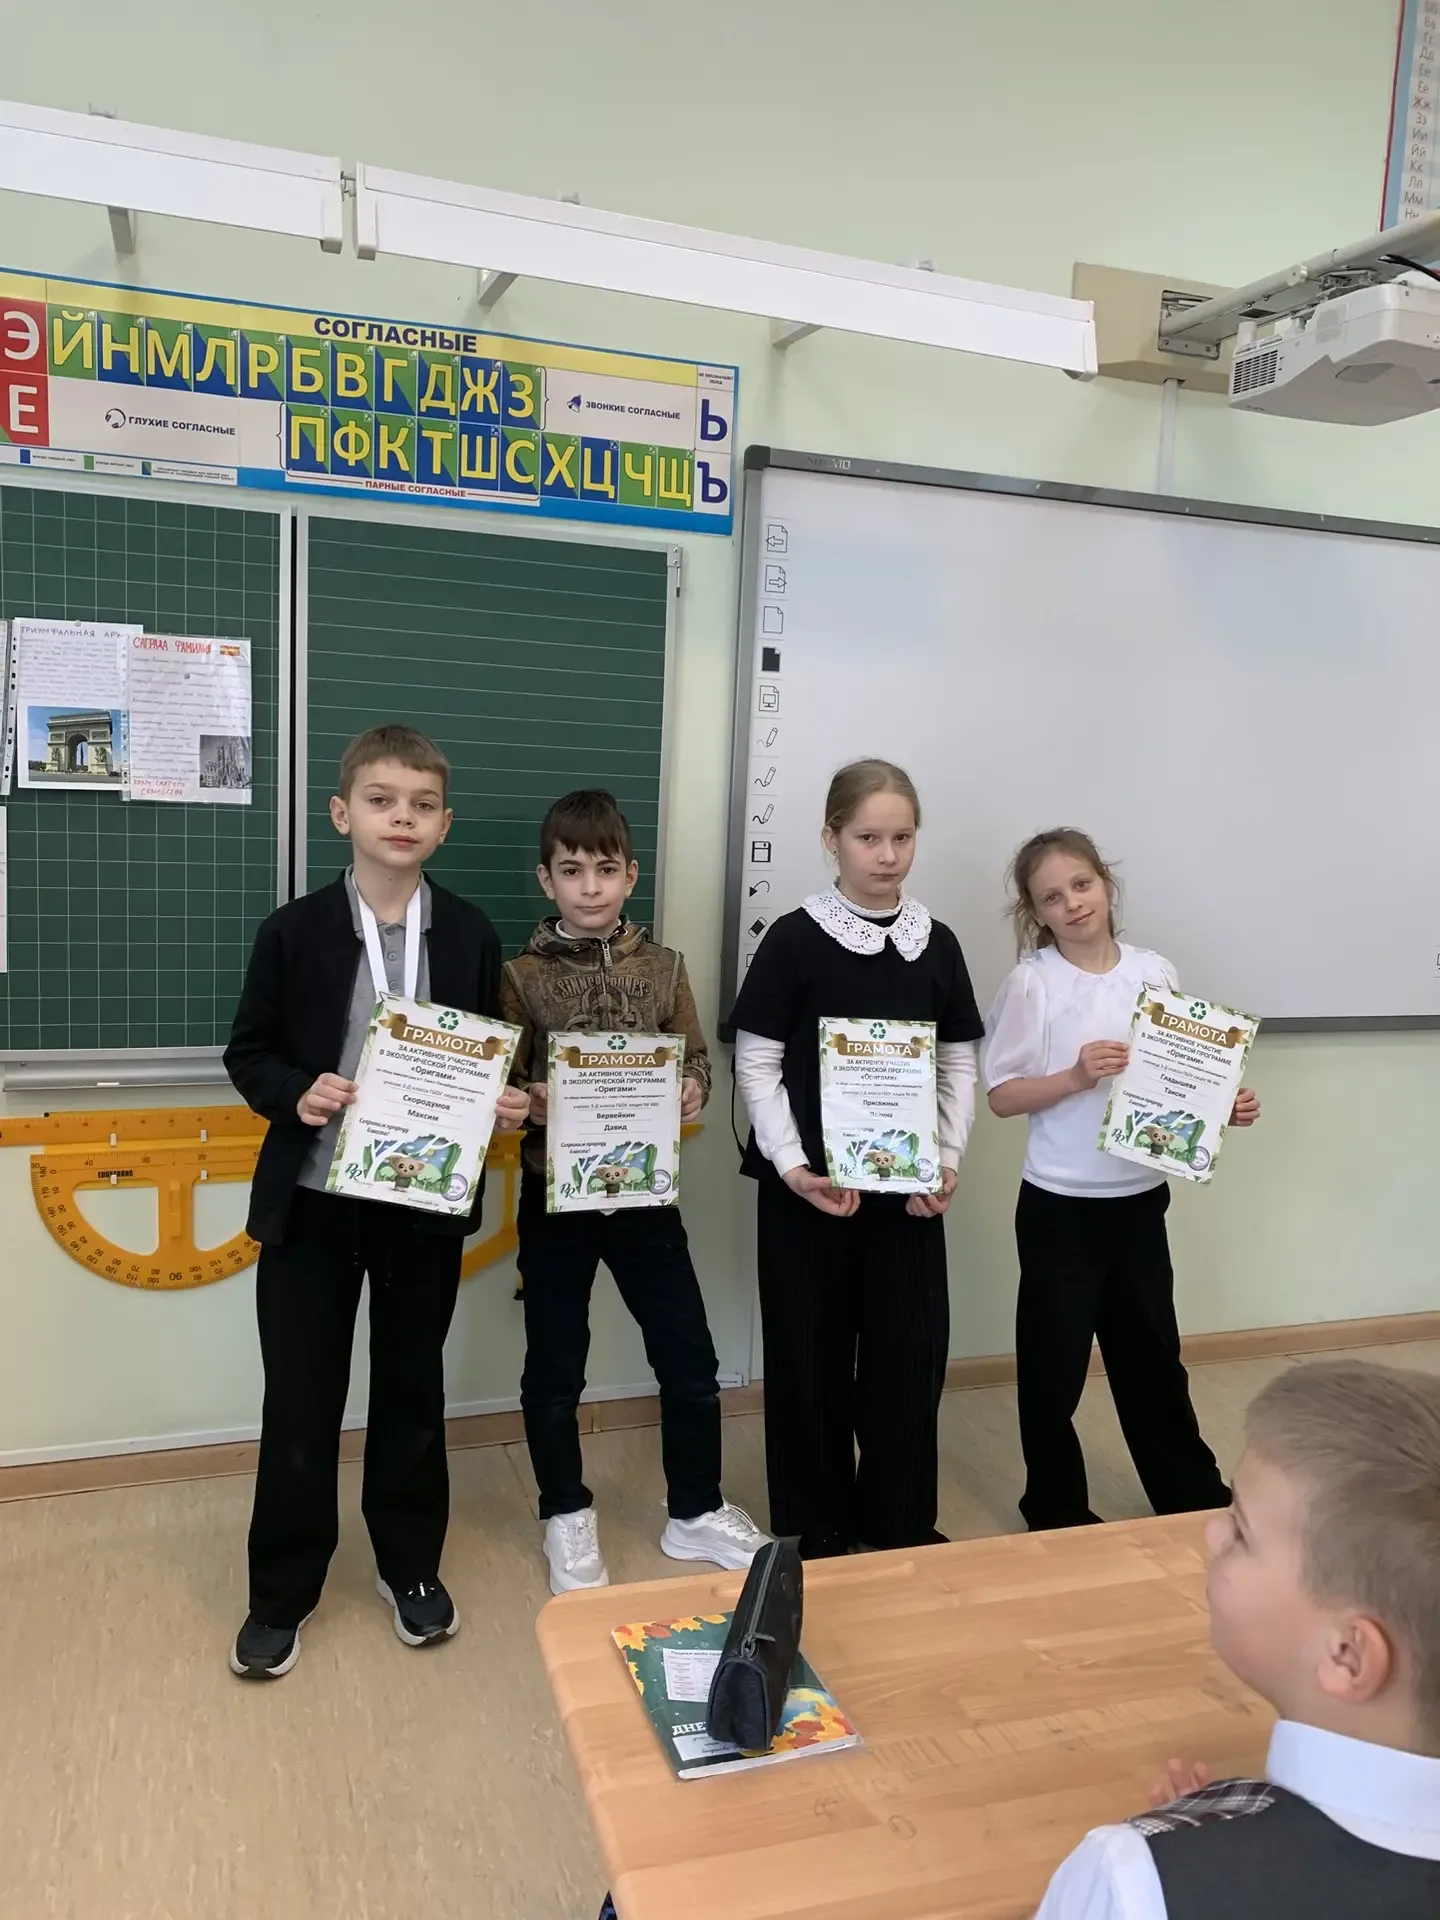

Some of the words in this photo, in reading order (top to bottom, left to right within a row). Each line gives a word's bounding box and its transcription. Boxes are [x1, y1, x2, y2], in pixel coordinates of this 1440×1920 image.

[1419, 46, 1435, 61] Дд
[1412, 127, 1428, 141] Ии
[1411, 143, 1426, 157] Йй
[1410, 160, 1423, 172] Кк
[1404, 191, 1423, 205] Мм
[1405, 207, 1419, 220] Нн
[3, 310, 40, 361] Э
[314, 317, 477, 353] СОГЛАСНЫЕ
[53, 310, 93, 369] Й
[102, 323, 140, 373] Н
[147, 329, 190, 380] М
[196, 337, 236, 385] Л
[248, 343, 279, 388] Р
[291, 347, 324, 393] Б
[336, 352, 368, 398] В
[383, 358, 408, 402] Г
[420, 363, 456, 416] Д
[461, 367, 499, 415] Ж
[508, 374, 534, 418] З
[9, 384, 39, 433] Е
[585, 401, 626, 413] ЗВОНКИЕ
[627, 406, 681, 420] СОГЛАСНЫЕ
[128, 416, 169, 428] ГЛУХИЕ
[171, 421, 236, 435] СОГЛАСНЫЕ
[700, 398, 728, 441] Ь
[290, 415, 325, 462] П
[333, 420, 370, 466] Ф
[379, 424, 410, 471] К
[421, 429, 453, 475] Т
[460, 434, 497, 480] Ш
[505, 439, 535, 484] С
[544, 442, 575, 489] Х
[583, 447, 615, 499] Ц
[624, 452, 652, 497] Ч
[658, 456, 692, 507] Щ
[365, 480, 406, 491] ПАРНЫЕ
[408, 485, 466, 497] СОГЛАСНЫЕ
[697, 461, 728, 503] Ъ
[20, 625, 95, 637] ТРИУМФАЛЬНАЯ
[1160, 1014, 1227, 1044] ГРАМОТА
[402, 1026, 484, 1056] ГРАМОТА
[846, 1042, 912, 1056] ГРАМОТА
[1165, 1033, 1195, 1046] АКТИВНОЕ
[1196, 1042, 1222, 1055] УЧАСТИЕ
[398, 1044, 407, 1052] ЗА
[409, 1047, 446, 1060] АКТИВНОЕ
[447, 1056, 478, 1068] УЧАСТИЕ
[1146, 1034, 1196, 1054] ЭКОЛОГИЧЕСКОЙ
[1196, 1050, 1232, 1065] ПРОГРАММЕ
[1167, 1049, 1204, 1065] «Оригами»
[386, 1050, 446, 1069] ЭКОЛОГИЧЕСКОЙ
[447, 1064, 491, 1080] ПРОГРАММЕ
[580, 1055, 656, 1066] ГРАМОТА
[411, 1065, 456, 1081] «Оригами»
[838, 1065, 887, 1073] ЭКОЛОГИЧЕСКОЙ
[568, 1077, 625, 1085] ЭКОЛОГИЧЕСКОЙ
[594, 1085, 636, 1094] «Оригами»
[402, 1094, 451, 1110] Скородумов
[407, 1109, 439, 1121] Максим
[596, 1111, 635, 1120] Вервейкин
[603, 1124, 627, 1132] Давид
[41, 1187, 49, 1198] 170
[52, 1186, 59, 1194] 10
[169, 1272, 182, 1281] 90
